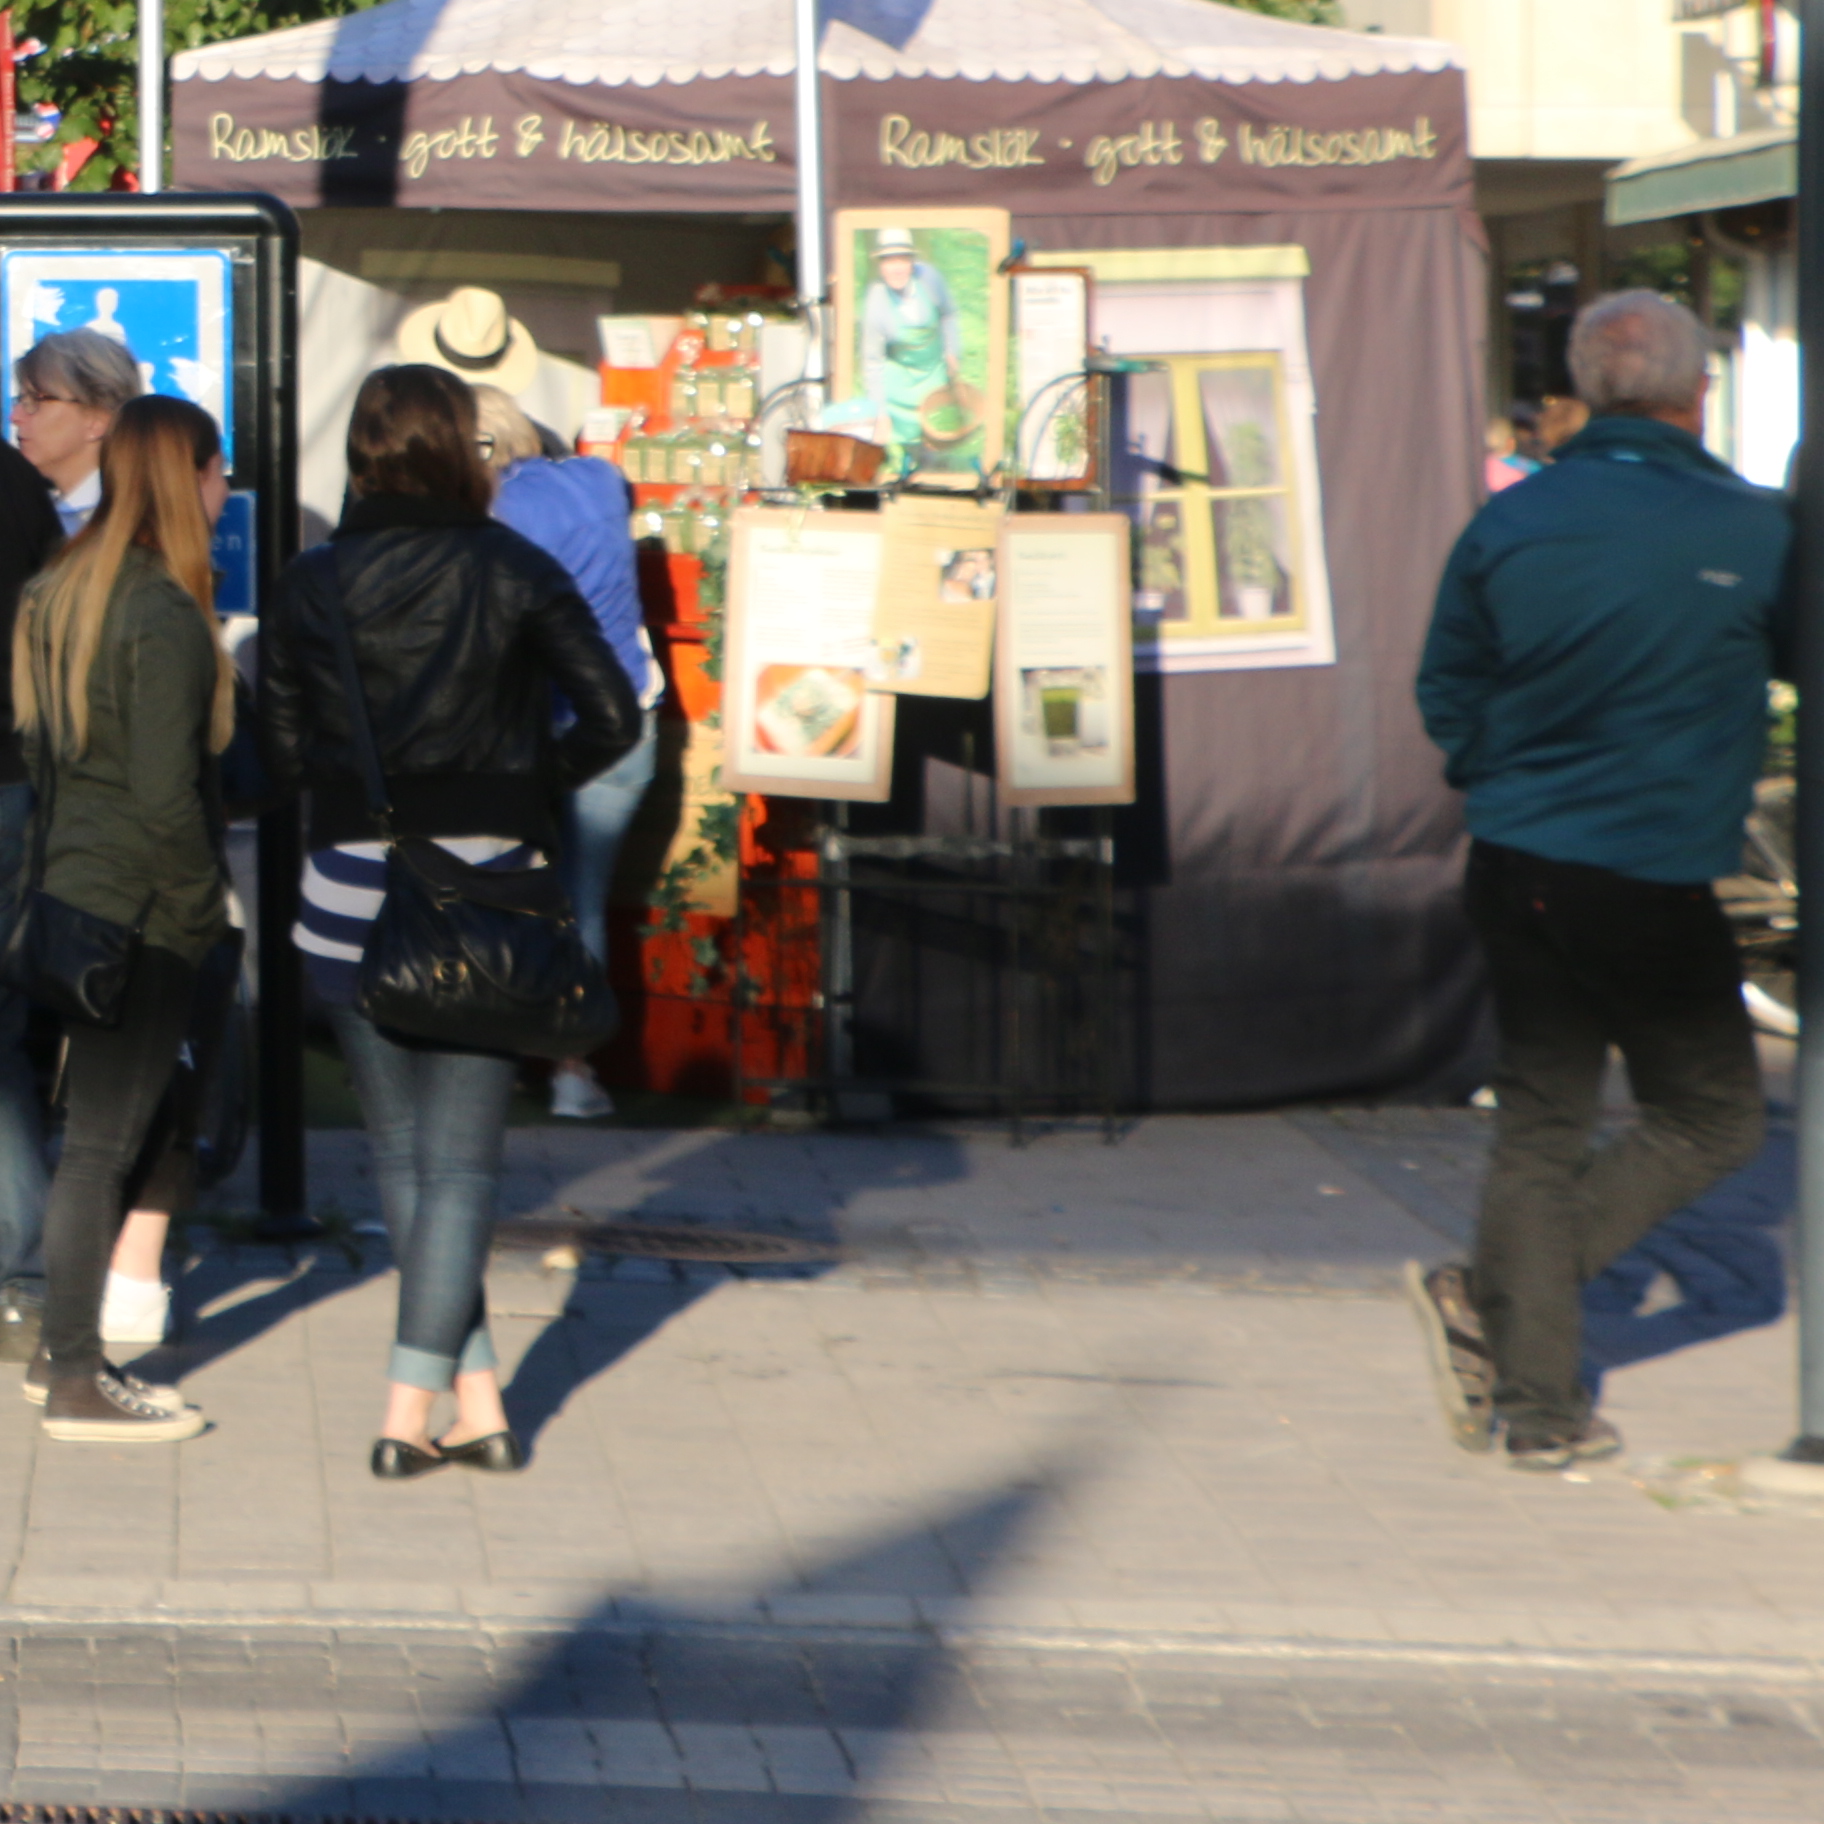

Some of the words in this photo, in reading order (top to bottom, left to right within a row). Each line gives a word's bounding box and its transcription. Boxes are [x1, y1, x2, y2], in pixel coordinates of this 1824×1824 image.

[209, 111, 358, 163] Ramslök
[398, 115, 500, 180] gott
[515, 113, 545, 158] &
[557, 119, 777, 165] hälsosamt
[880, 113, 1046, 169] Ramslök
[1084, 119, 1184, 187] gott
[1193, 117, 1229, 164] &
[1237, 115, 1437, 167] hälsosamt
